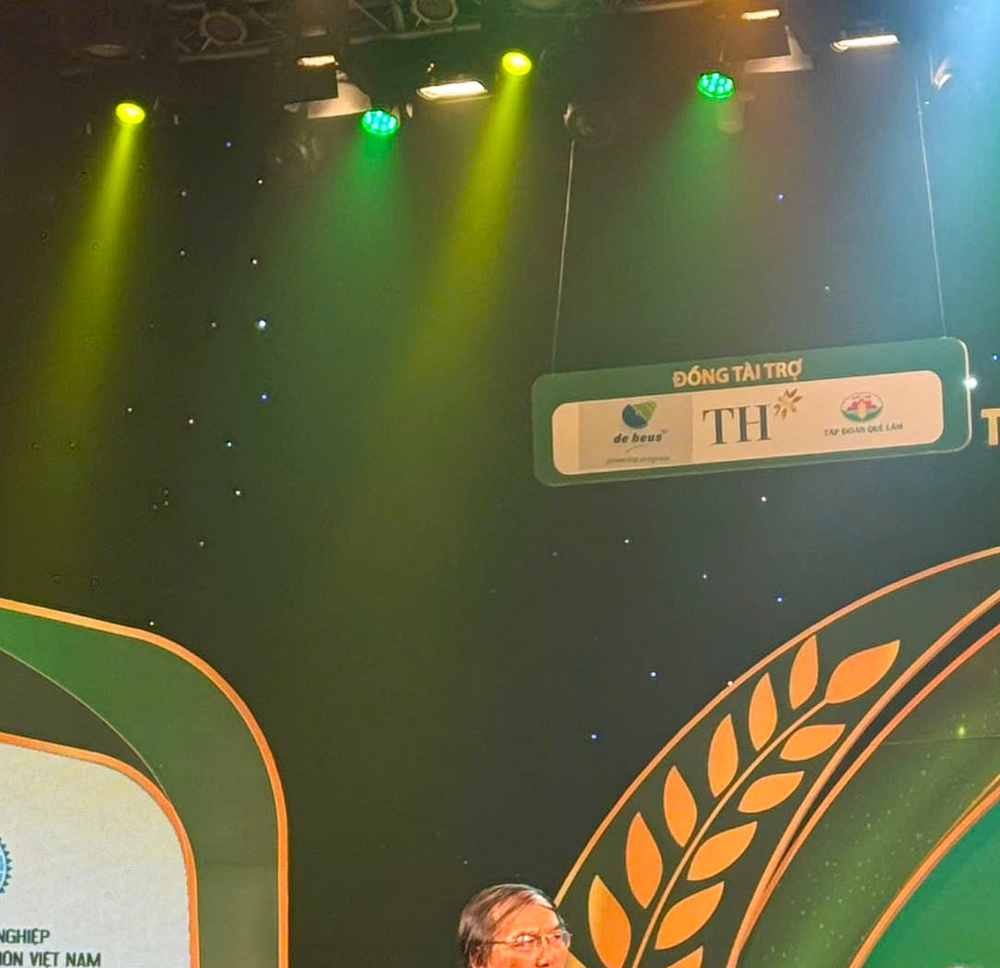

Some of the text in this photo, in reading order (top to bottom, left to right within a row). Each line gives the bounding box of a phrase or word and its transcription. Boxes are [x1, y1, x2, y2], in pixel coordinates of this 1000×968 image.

[731, 361, 761, 382] TÀI
[763, 358, 803, 380] TRỢ
[702, 403, 772, 446] TH
[29, 951, 60, 968] VIỆT
[65, 952, 102, 968] NAM
